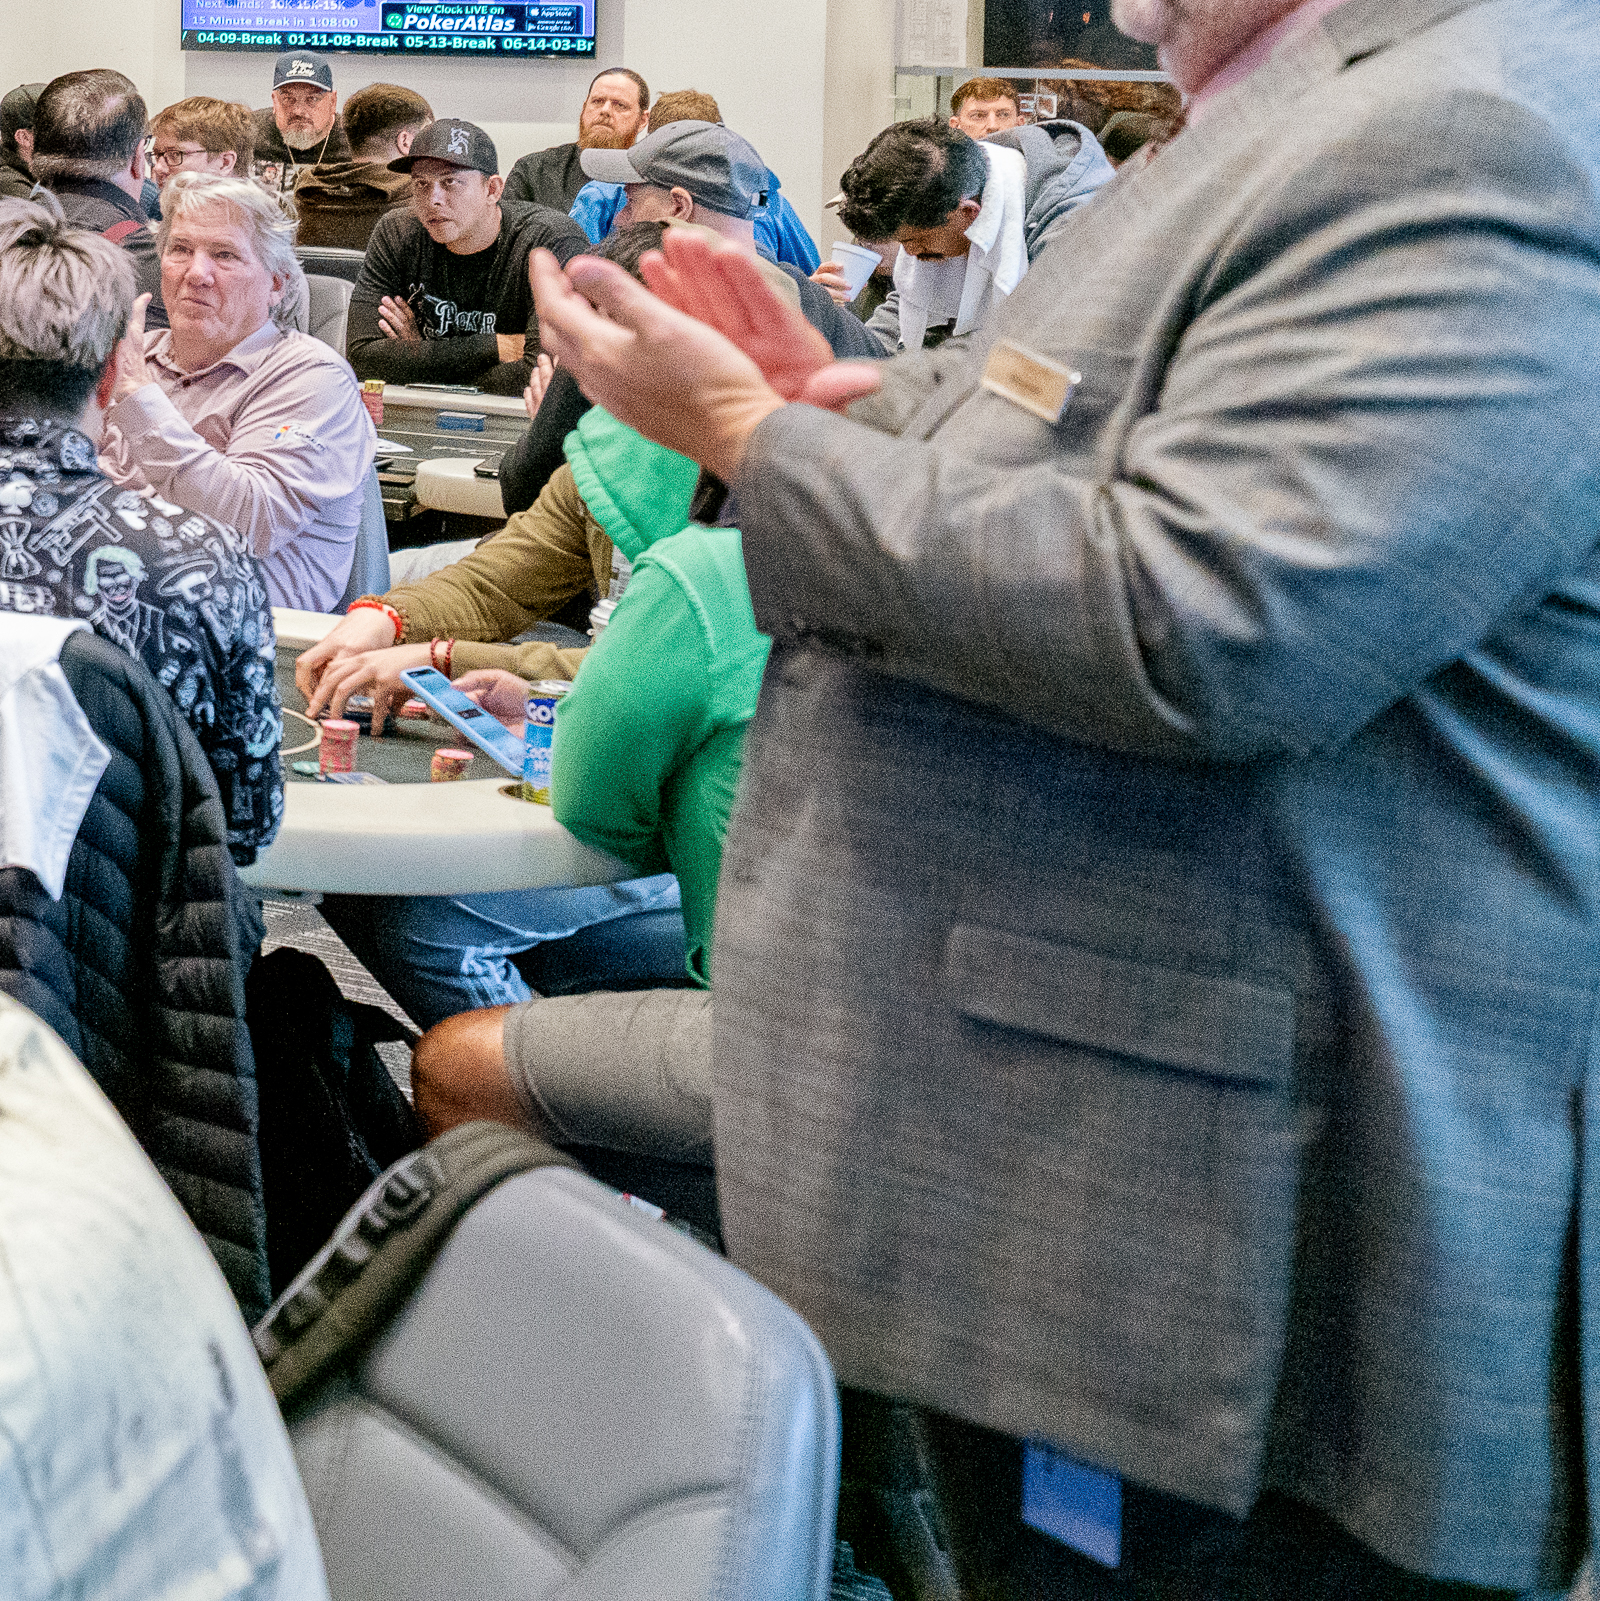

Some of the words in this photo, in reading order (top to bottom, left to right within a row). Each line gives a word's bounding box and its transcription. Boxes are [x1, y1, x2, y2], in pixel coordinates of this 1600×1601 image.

[195, 0, 222, 8] Next
[406, 4, 432, 15] View
[434, 4, 463, 15] Clock
[465, 5, 488, 15] LIVE
[490, 6, 505, 15] on
[192, 16, 206, 25] 15
[210, 17, 251, 26] Minute
[256, 17, 289, 26] Break
[293, 17, 304, 26] in
[309, 18, 358, 27] 1:08:00
[403, 15, 515, 31] PokerAtlas
[197, 32, 282, 45] 04-09-Break
[288, 34, 399, 48] 01-11-08-Break
[405, 36, 496, 50] 05-13-Break
[502, 37, 594, 51] 06-14-03-Br
[527, 702, 555, 722] GO
